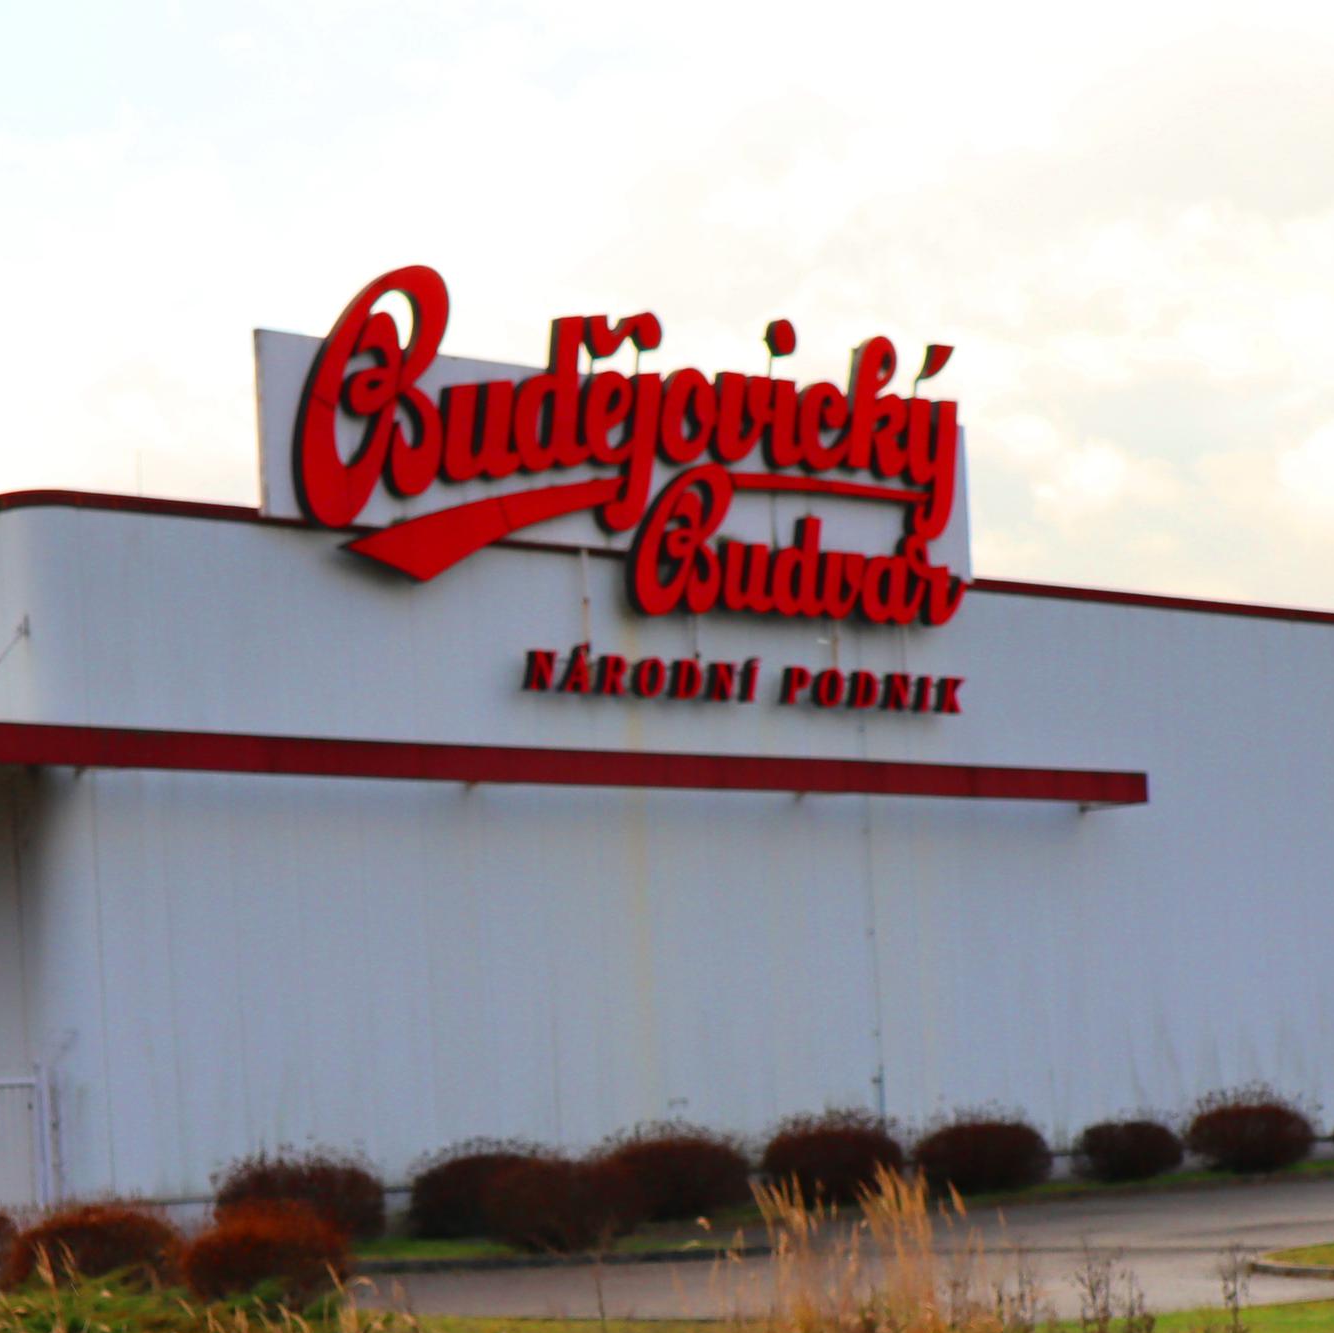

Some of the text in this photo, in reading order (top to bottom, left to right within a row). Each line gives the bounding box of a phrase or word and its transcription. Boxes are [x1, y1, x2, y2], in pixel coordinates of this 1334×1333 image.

[293, 264, 958, 582] Budějovický
[626, 462, 967, 626] Budvar
[522, 642, 965, 714] NÁRODNÍ PODNIK
